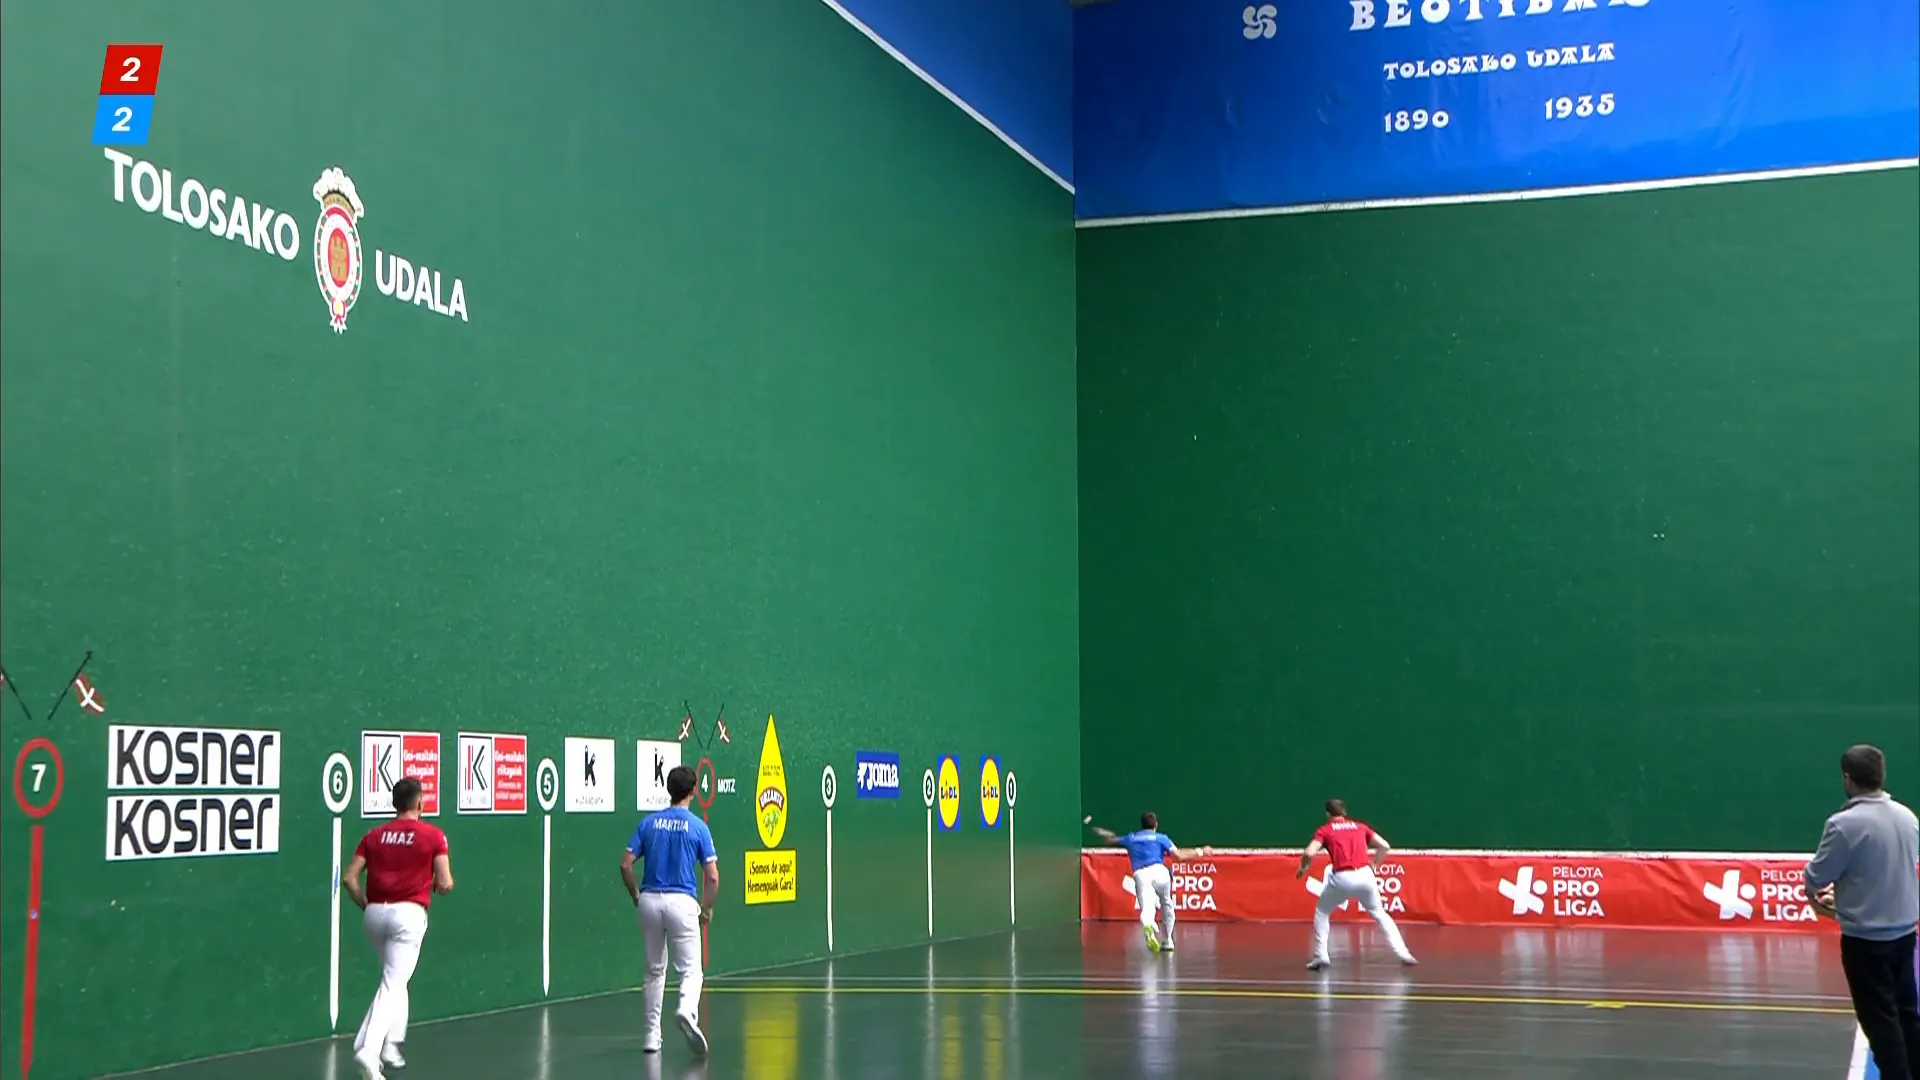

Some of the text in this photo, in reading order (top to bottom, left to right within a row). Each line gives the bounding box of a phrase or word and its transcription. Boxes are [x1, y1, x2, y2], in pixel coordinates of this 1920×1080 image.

[1383, 42, 1615, 80] TOLOSAKO UDALA
[1384, 93, 1615, 133] 1890 1935
[104, 148, 468, 322] TOLOSAKO UDALA
[31, 764, 46, 792] 7
[332, 771, 342, 794] 6
[543, 773, 551, 795] 5
[701, 773, 736, 793] 4 MOTZ
[825, 778, 832, 795] 3
[926, 779, 932, 797] 2
[381, 831, 414, 845] IMAZ
[771, 860, 778, 874] de
[1171, 863, 1217, 875] PELOTA
[1374, 863, 1406, 876] LOTA
[1552, 866, 1604, 879] PELOTA
[1761, 869, 1805, 882] PELOT
[1171, 875, 1214, 892] PRO
[1553, 879, 1600, 898] PRO
[1171, 894, 1217, 911] LIGA
[1553, 899, 1605, 917] LIGA
[1762, 903, 1818, 922] LIGA
